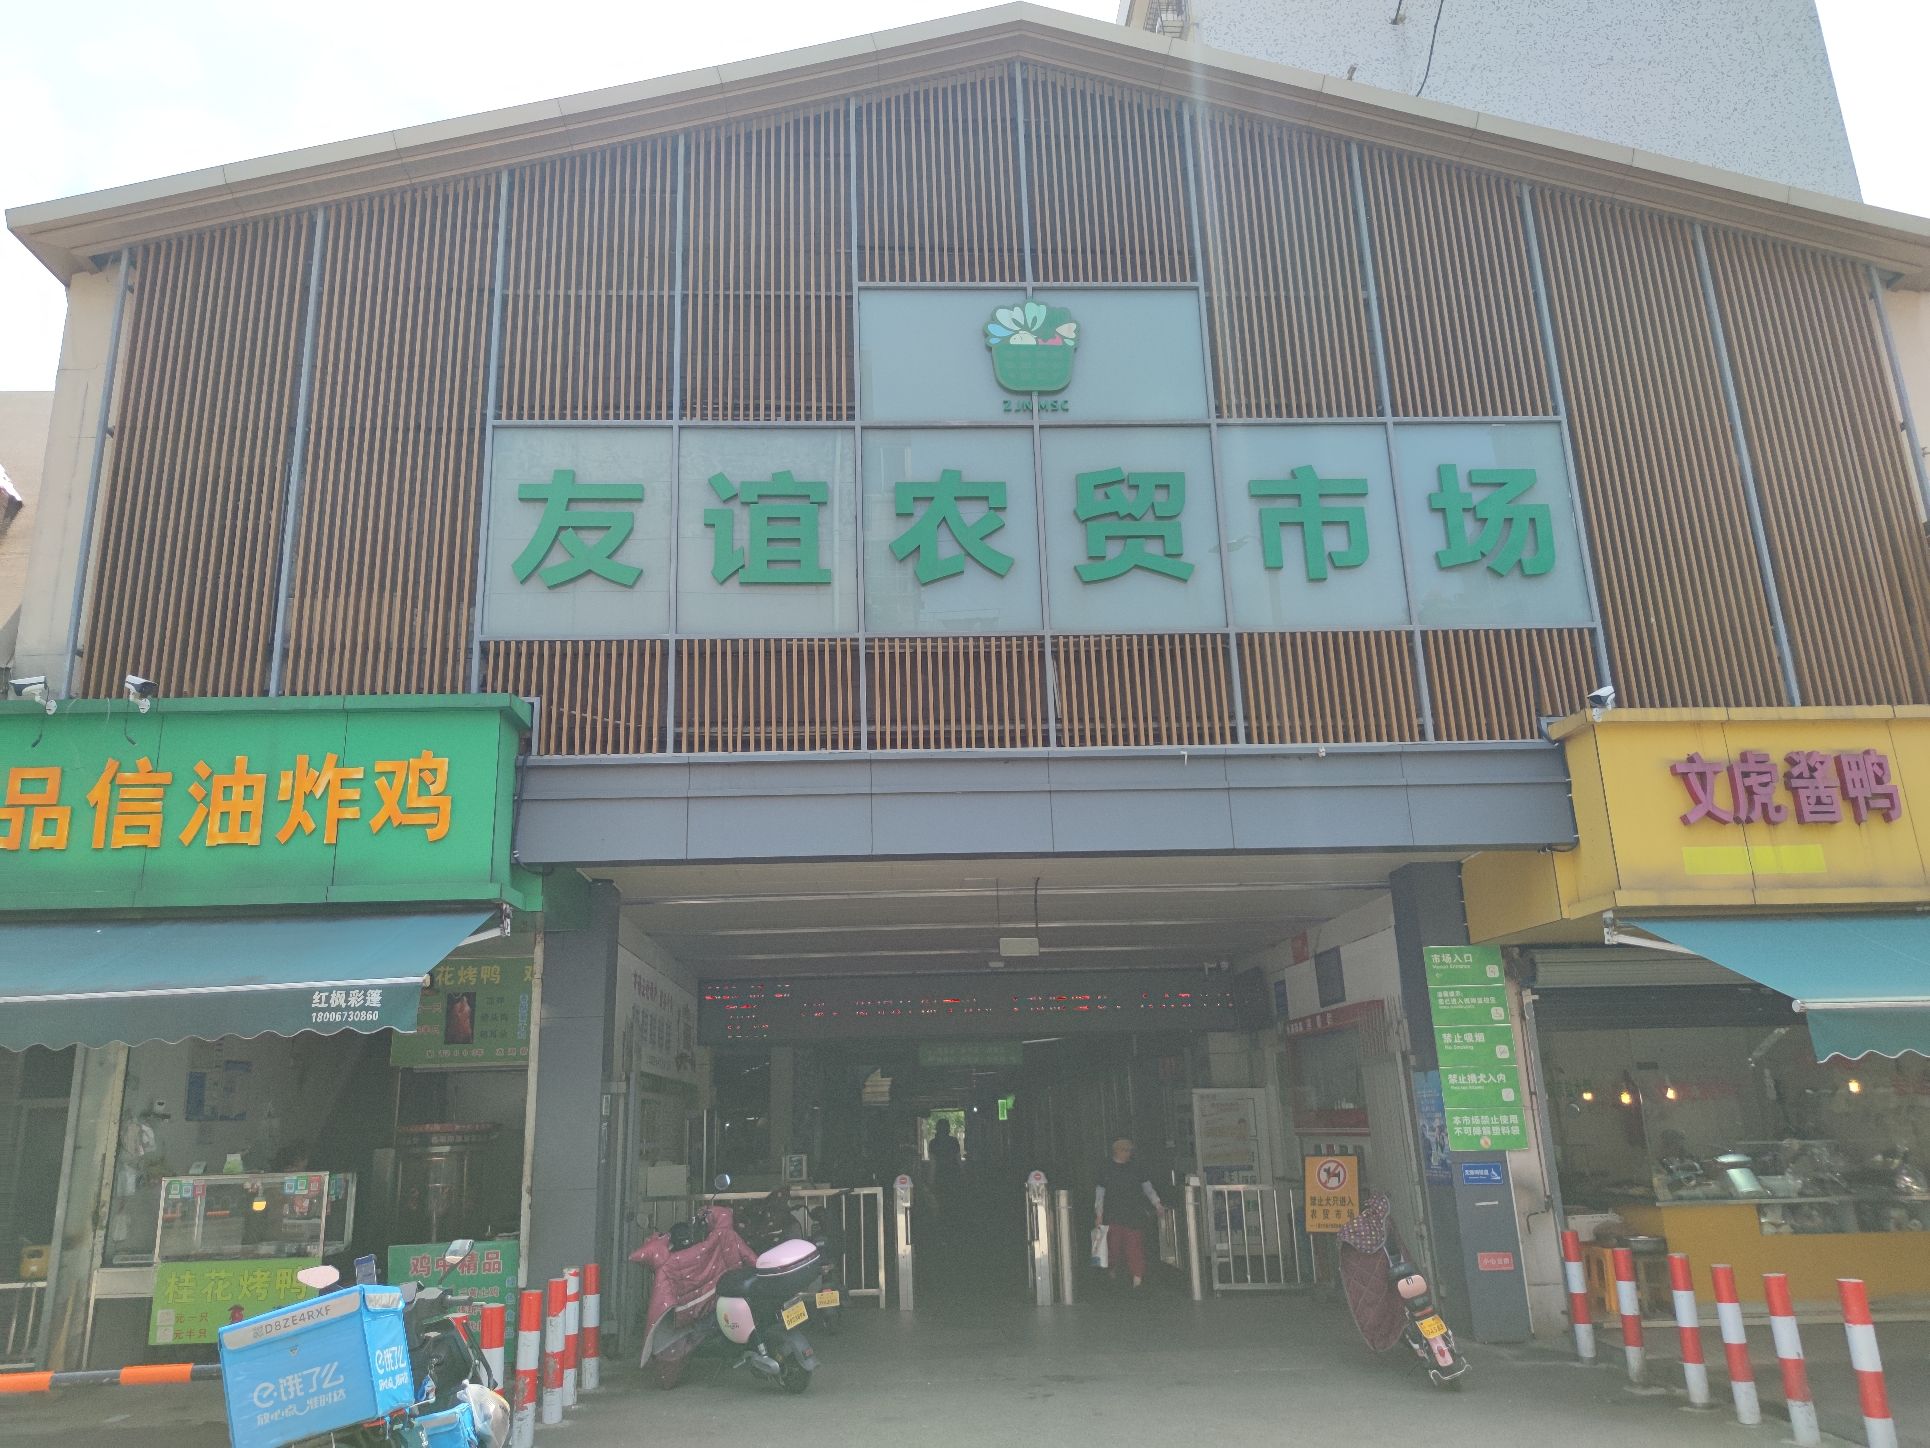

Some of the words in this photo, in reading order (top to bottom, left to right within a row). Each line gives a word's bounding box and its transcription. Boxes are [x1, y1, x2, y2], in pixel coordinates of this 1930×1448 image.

[511, 463, 1557, 590] 友谊农贸市场
[1669, 748, 1903, 826] 文虎酱鸭
[0, 749, 454, 851] 品信油炸鸡
[1431, 953, 1473, 964] 市场入口
[435, 965, 502, 986] 花烤鸭
[311, 988, 383, 1008] 红枫彩篷
[311, 1009, 380, 1023] 18006730860
[1441, 1032, 1486, 1044] 禁止吸烟
[1452, 1114, 1519, 1126] 本市场禁止使用
[1454, 1125, 1521, 1137] 不可降解塑料袋
[165, 1267, 309, 1305] 桂花烤鸭
[264, 1304, 332, 1336] D8ZE4RXF
